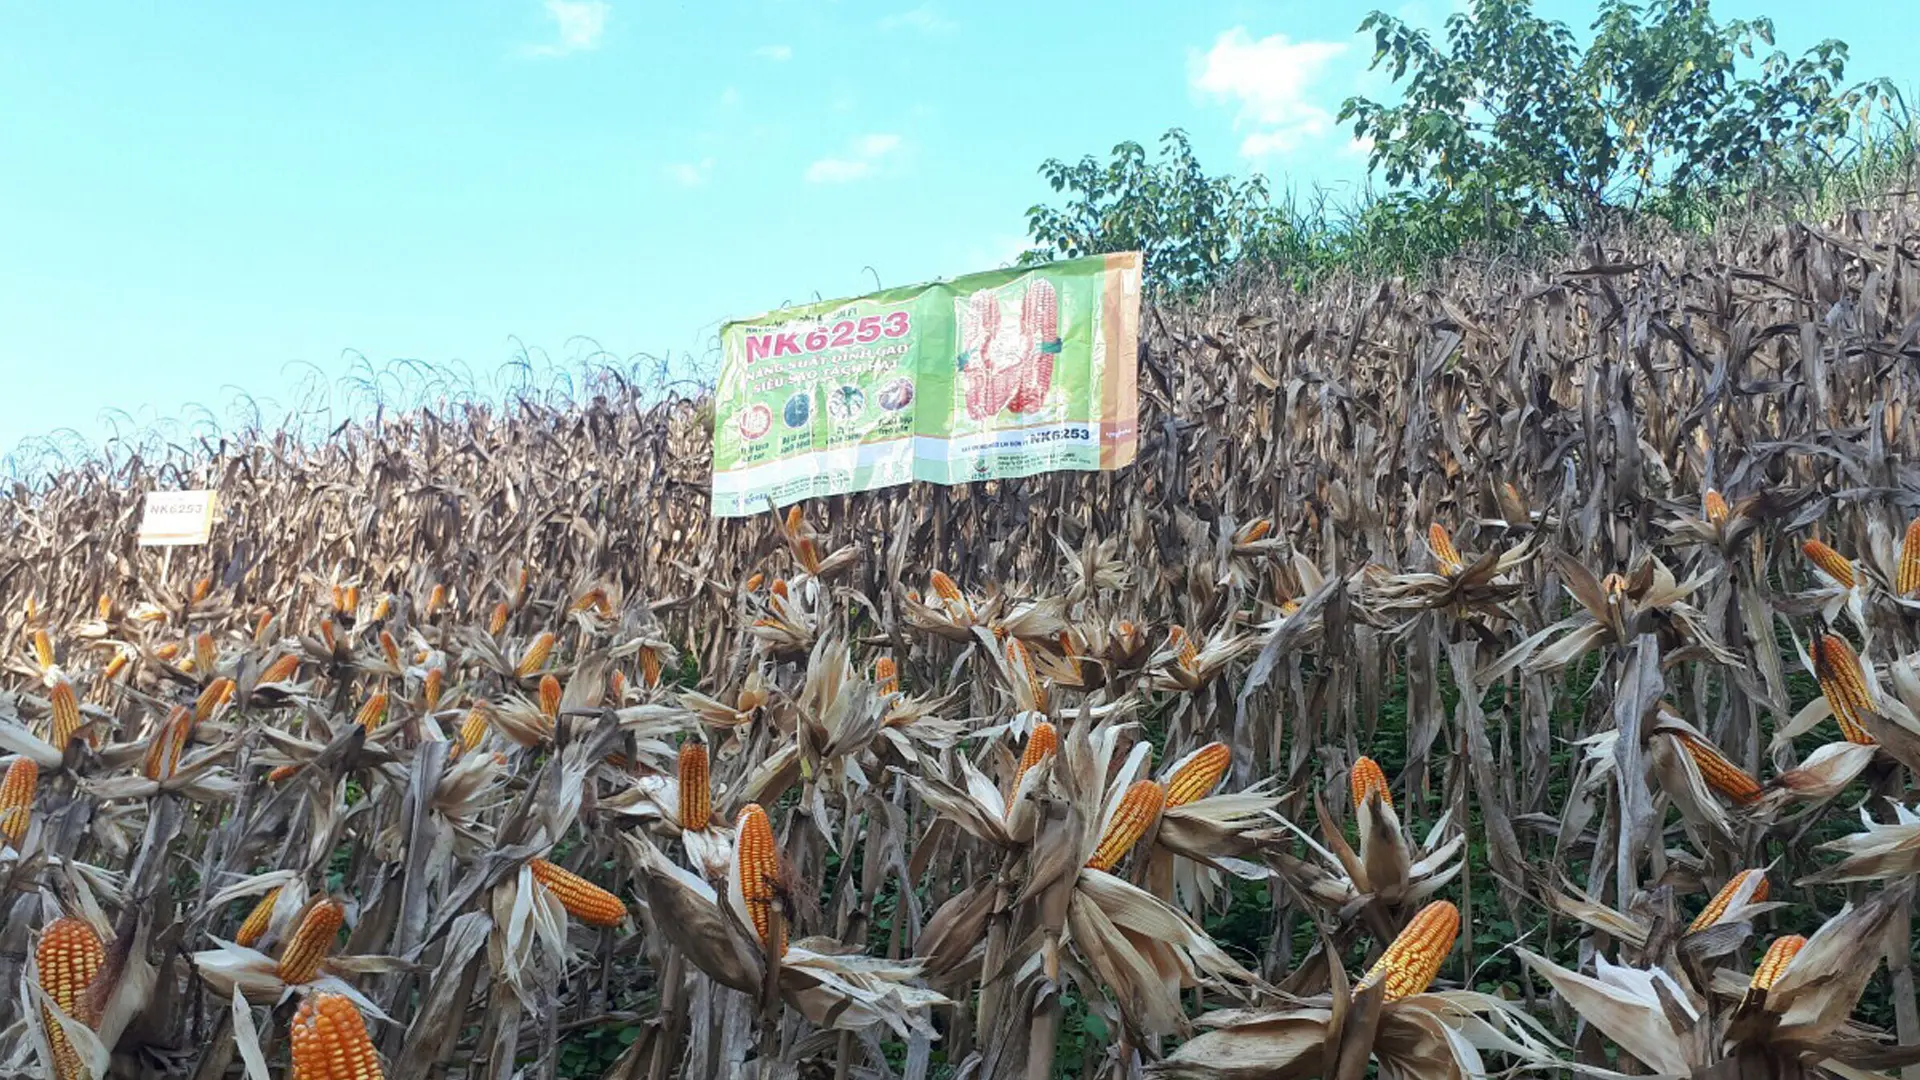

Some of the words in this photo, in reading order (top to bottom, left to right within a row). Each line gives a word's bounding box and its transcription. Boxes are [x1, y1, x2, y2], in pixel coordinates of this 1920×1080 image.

[745, 311, 910, 365] NK6253
[1030, 427, 1091, 445] NK6253
[150, 503, 204, 516] NK6253
